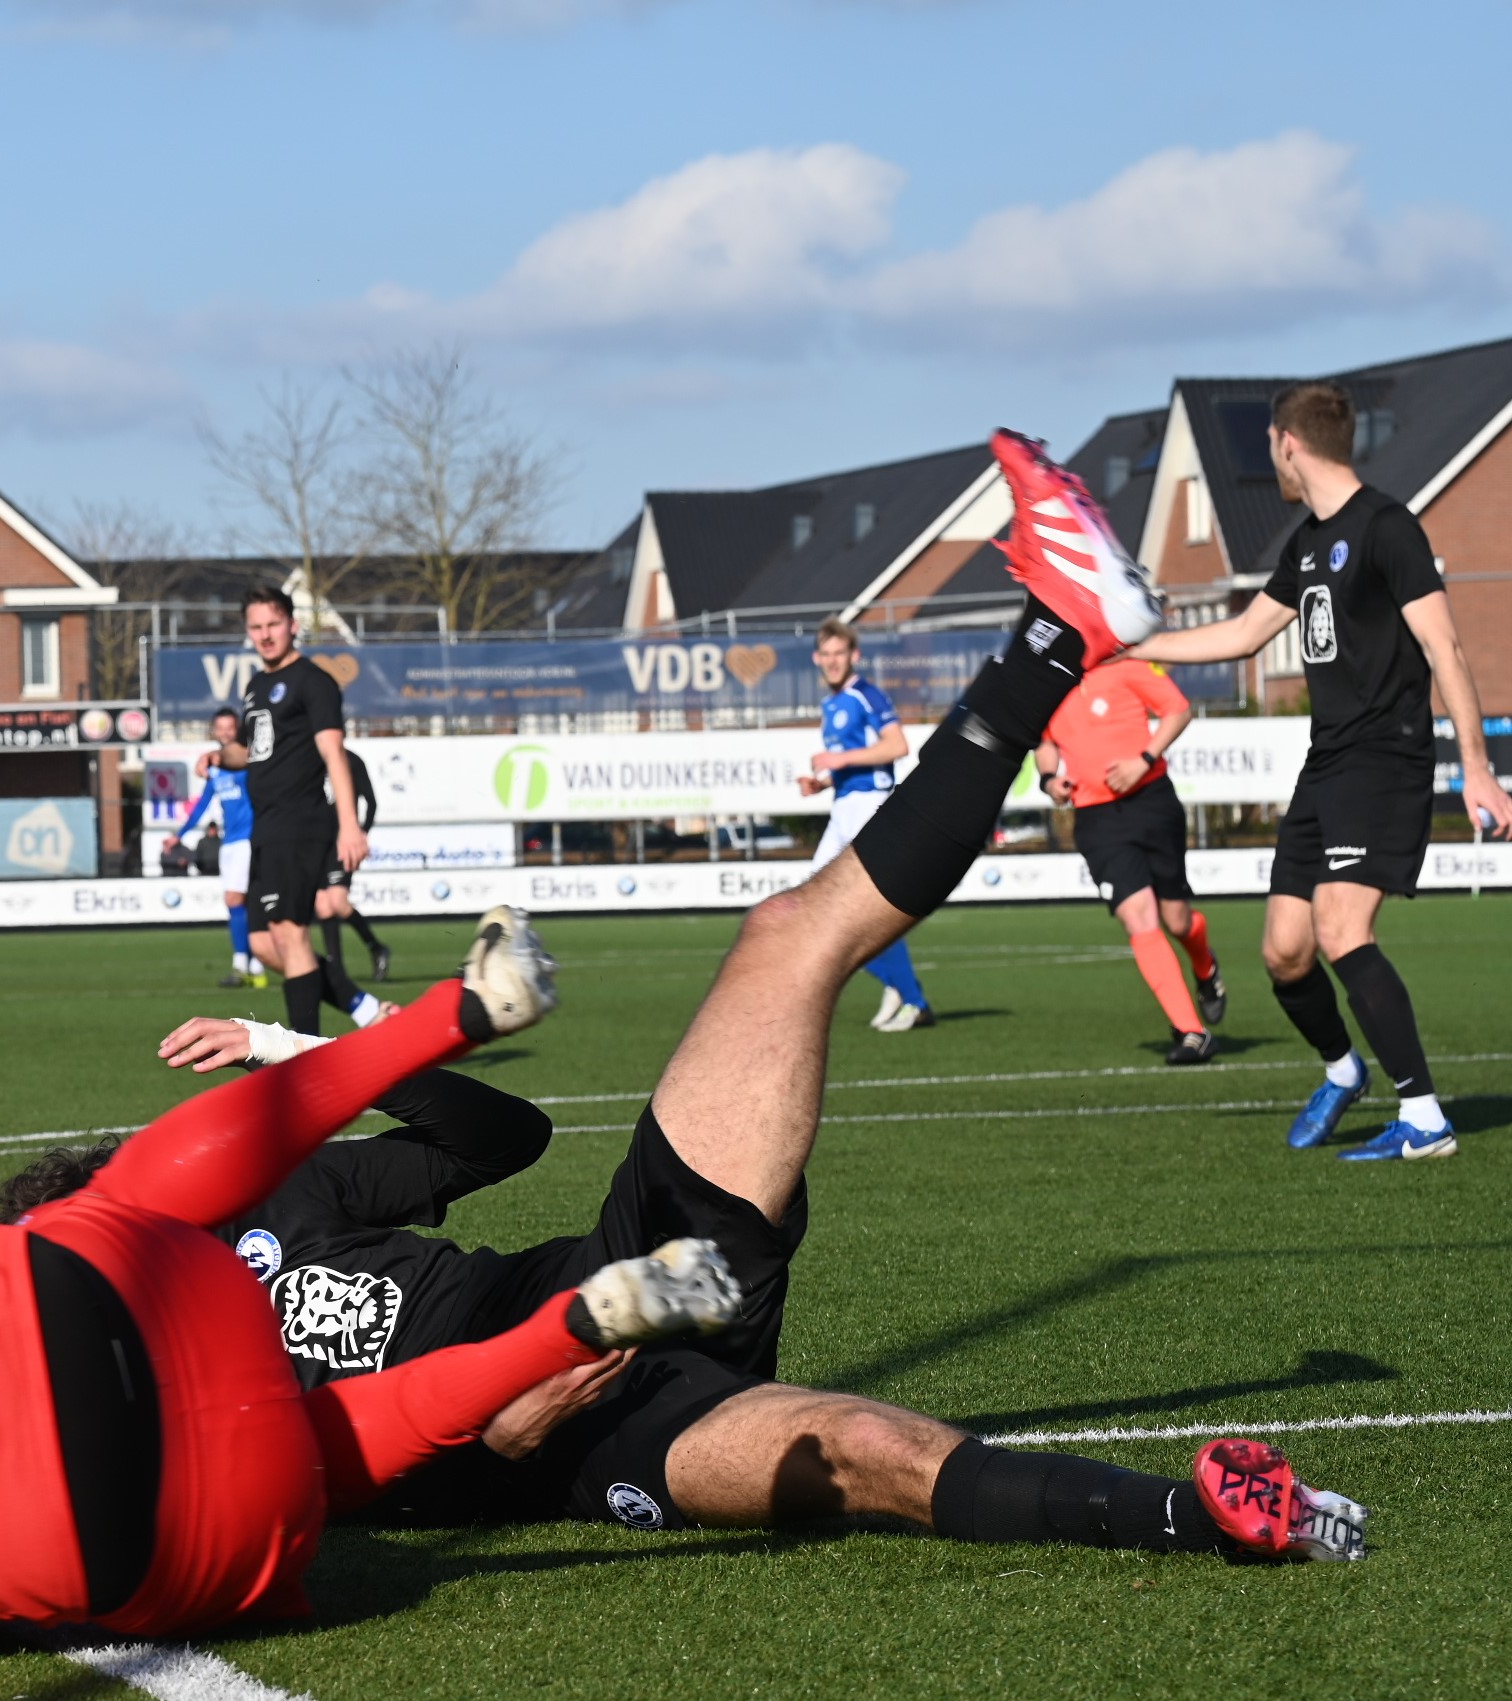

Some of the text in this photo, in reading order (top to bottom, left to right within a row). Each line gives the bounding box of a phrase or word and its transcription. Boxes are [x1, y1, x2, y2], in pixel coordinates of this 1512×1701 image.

[201, 653, 264, 699] VD
[622, 643, 725, 694] VDB
[563, 762, 614, 791] VAN
[620, 759, 777, 789] DUINKERKEN
[1435, 853, 1497, 878] Ekris
[531, 876, 597, 900] Ekris
[719, 870, 788, 897] Ekris
[74, 888, 141, 913] Ekris
[1218, 1466, 1364, 1554] PREDATOR
